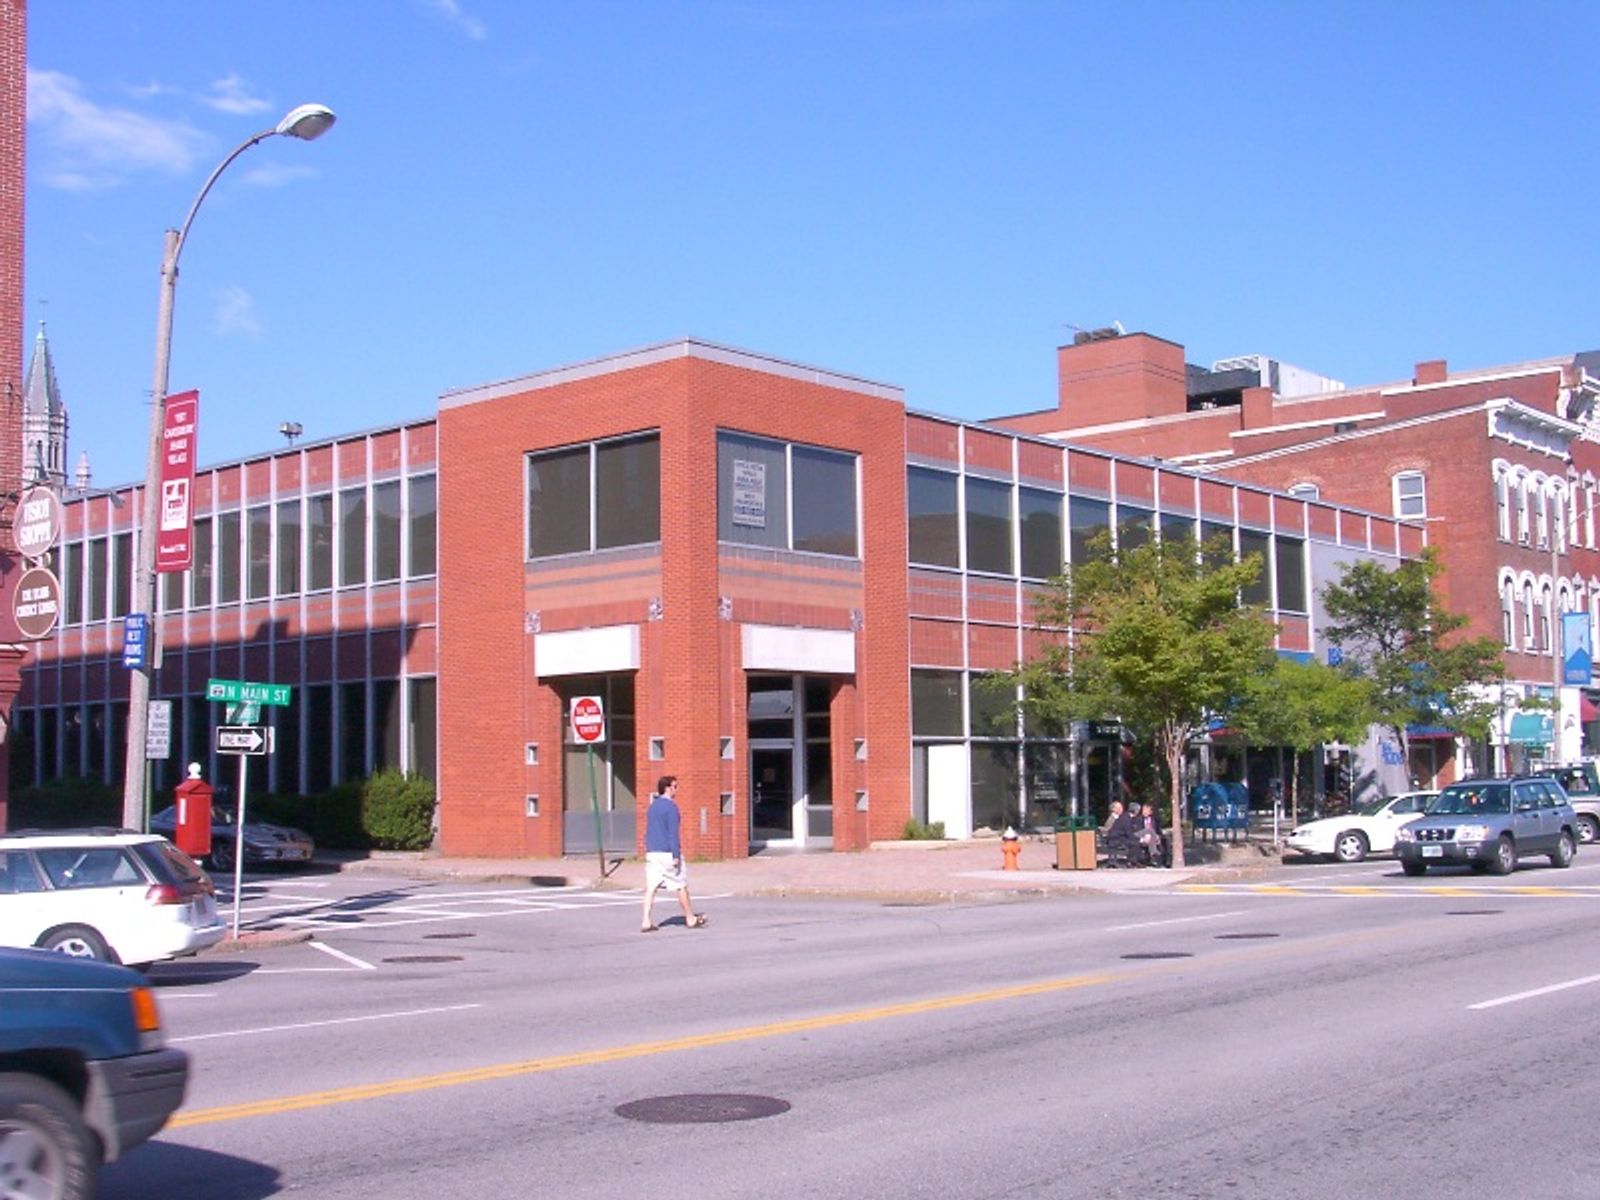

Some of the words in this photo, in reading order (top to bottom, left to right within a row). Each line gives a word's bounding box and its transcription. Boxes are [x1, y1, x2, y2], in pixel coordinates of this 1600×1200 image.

[227, 685, 235, 697] N
[241, 686, 269, 700] MAIN
[273, 690, 287, 702] ST
[580, 725, 598, 734] ENTER
[222, 735, 235, 745] ONE
